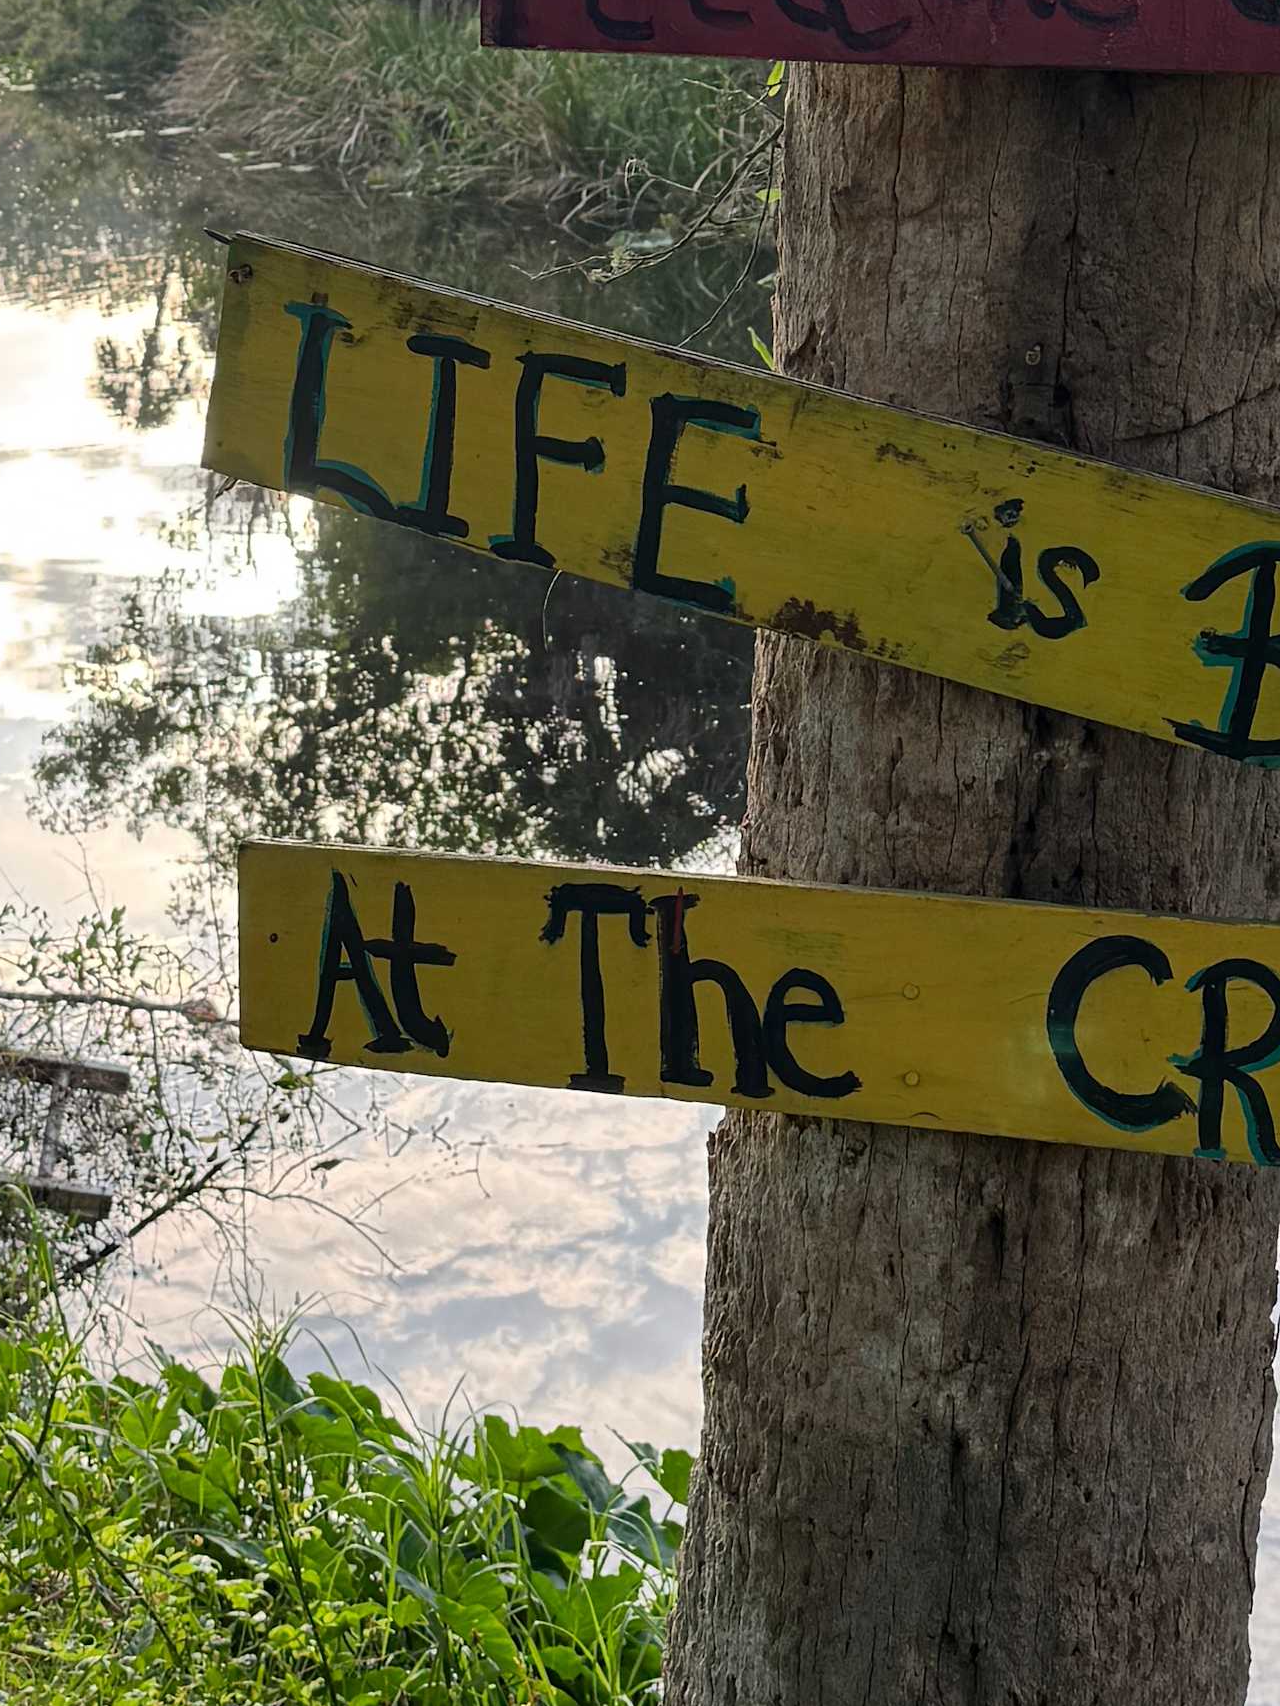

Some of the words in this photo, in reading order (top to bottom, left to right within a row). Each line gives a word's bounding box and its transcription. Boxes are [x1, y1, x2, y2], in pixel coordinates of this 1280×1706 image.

[283, 299, 765, 615] LIFE
[984, 496, 1101, 640] is
[296, 867, 458, 1058] At
[538, 881, 863, 1100] The
